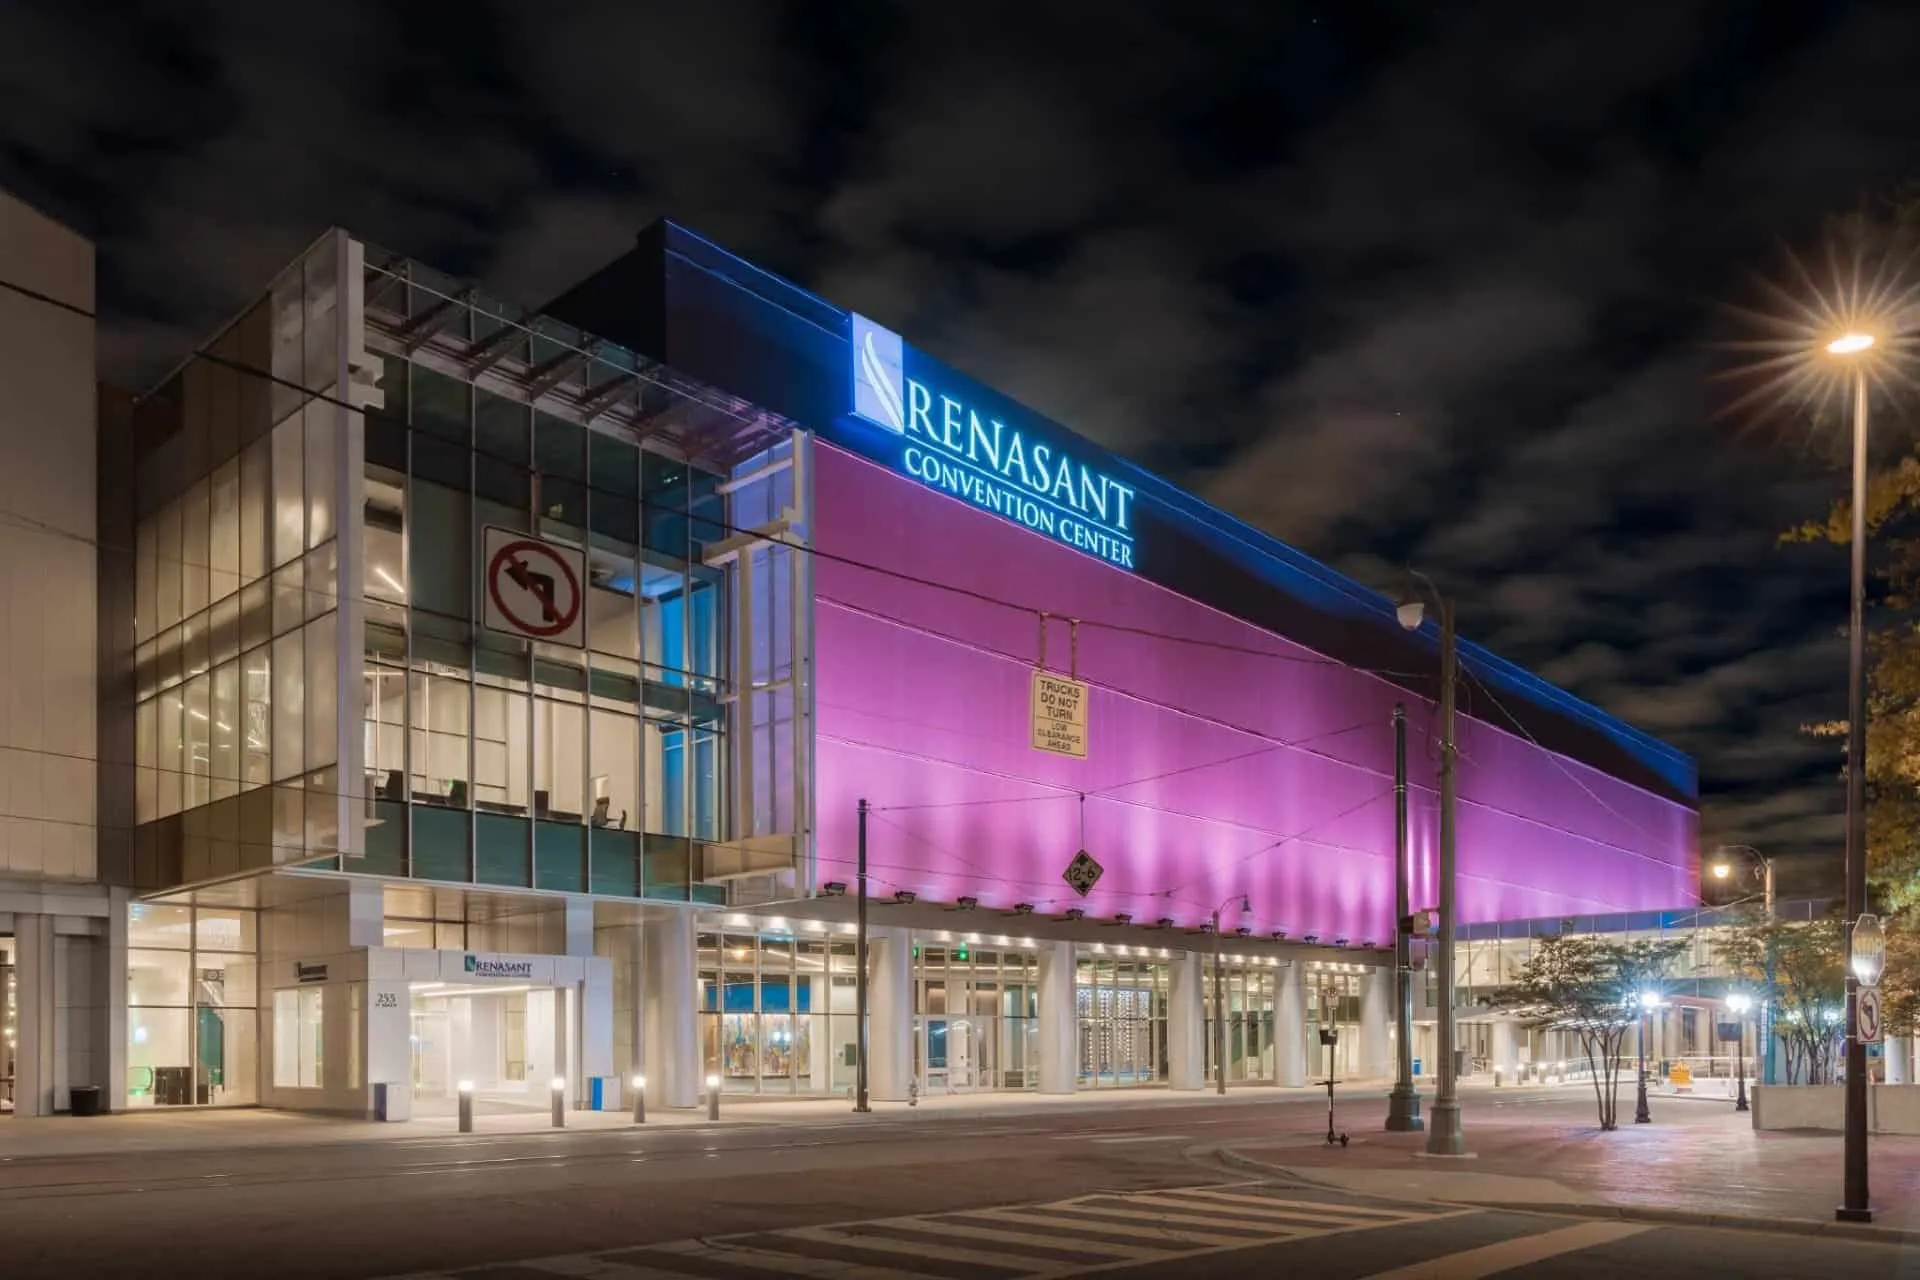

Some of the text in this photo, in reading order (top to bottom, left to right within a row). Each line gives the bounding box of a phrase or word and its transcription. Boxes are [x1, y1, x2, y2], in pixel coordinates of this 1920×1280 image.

[906, 378, 1136, 530] RENASANT
[904, 447, 1135, 568] CONVENTION CENTER
[1040, 680, 1080, 698] TRUCKS
[1041, 692, 1078, 710] DO NOT
[1046, 705, 1073, 720] TURN
[476, 961, 533, 973] RENASANT
